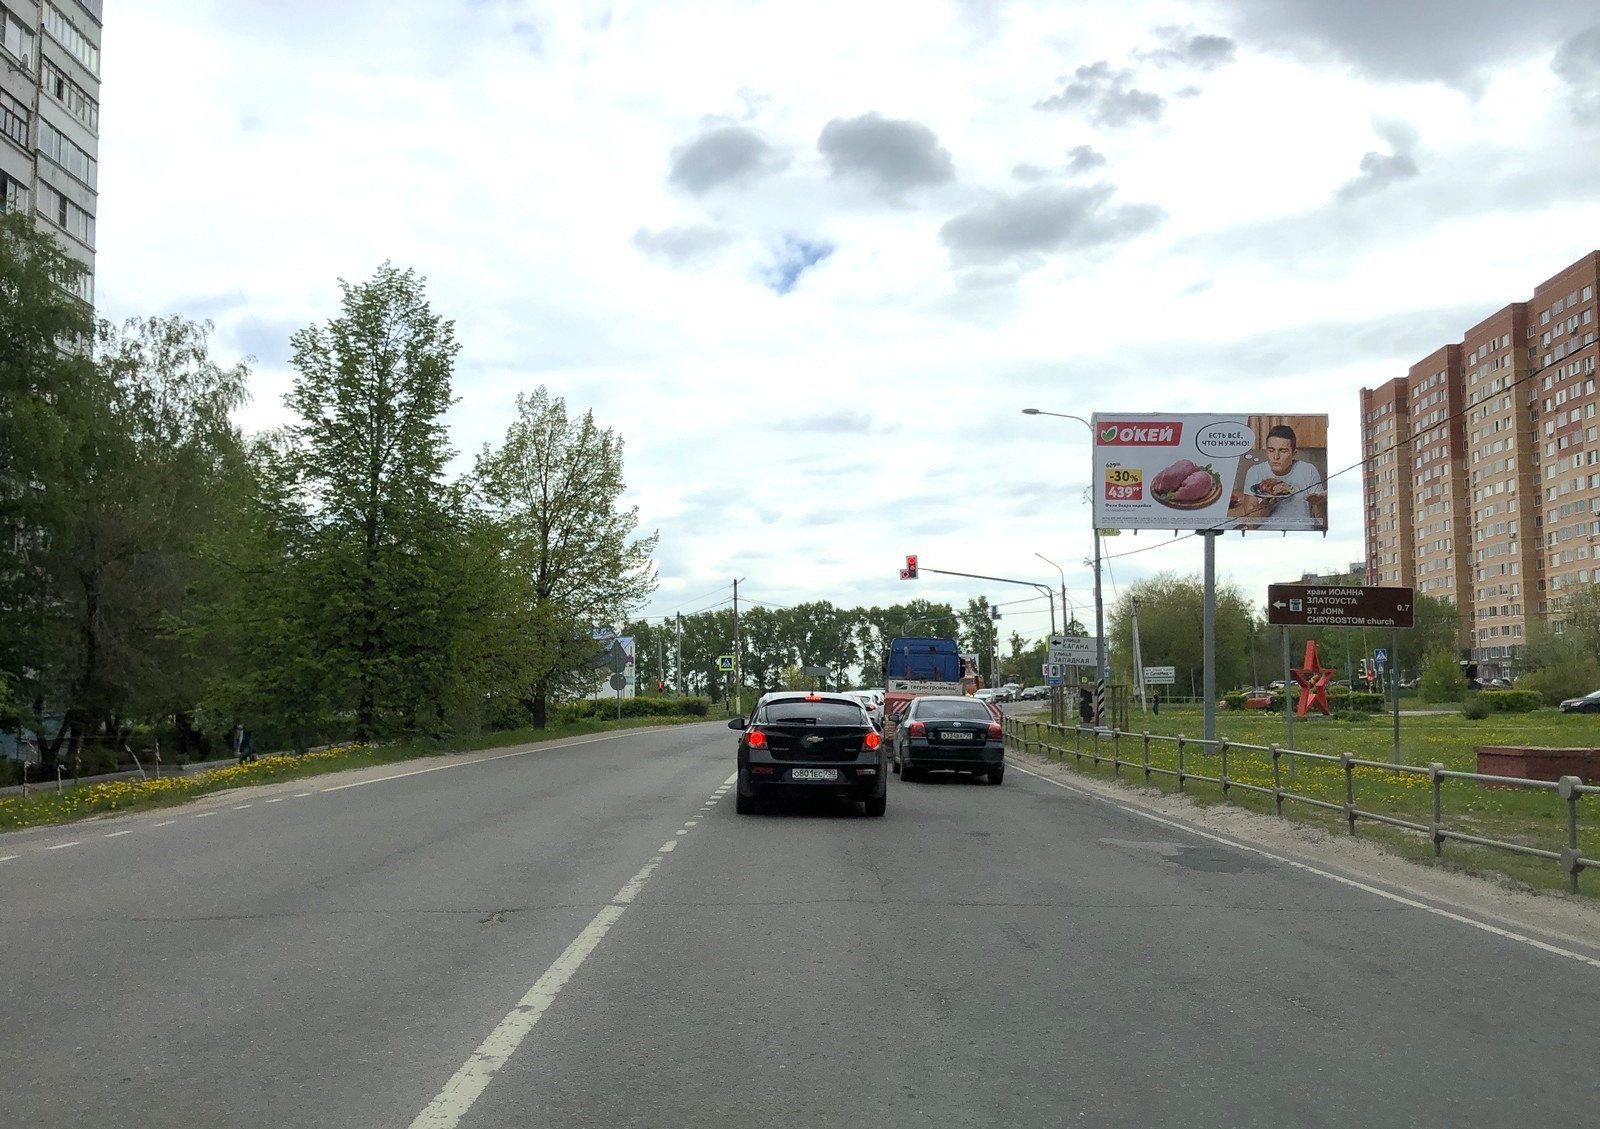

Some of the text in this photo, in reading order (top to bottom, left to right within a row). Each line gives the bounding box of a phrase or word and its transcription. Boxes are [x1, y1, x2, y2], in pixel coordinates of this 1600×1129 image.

[1109, 470, 1139, 482] -30%
[1328, 588, 1364, 596] ИОАННА
[1307, 597, 1358, 605] ЗЛАТОУСТА
[1306, 607, 1319, 615] ST.
[1396, 604, 1410, 612] 0.7
[1306, 616, 1394, 626] CHRYSOSTOM church
[1053, 656, 1090, 664] ЗАПАДНАЯ
